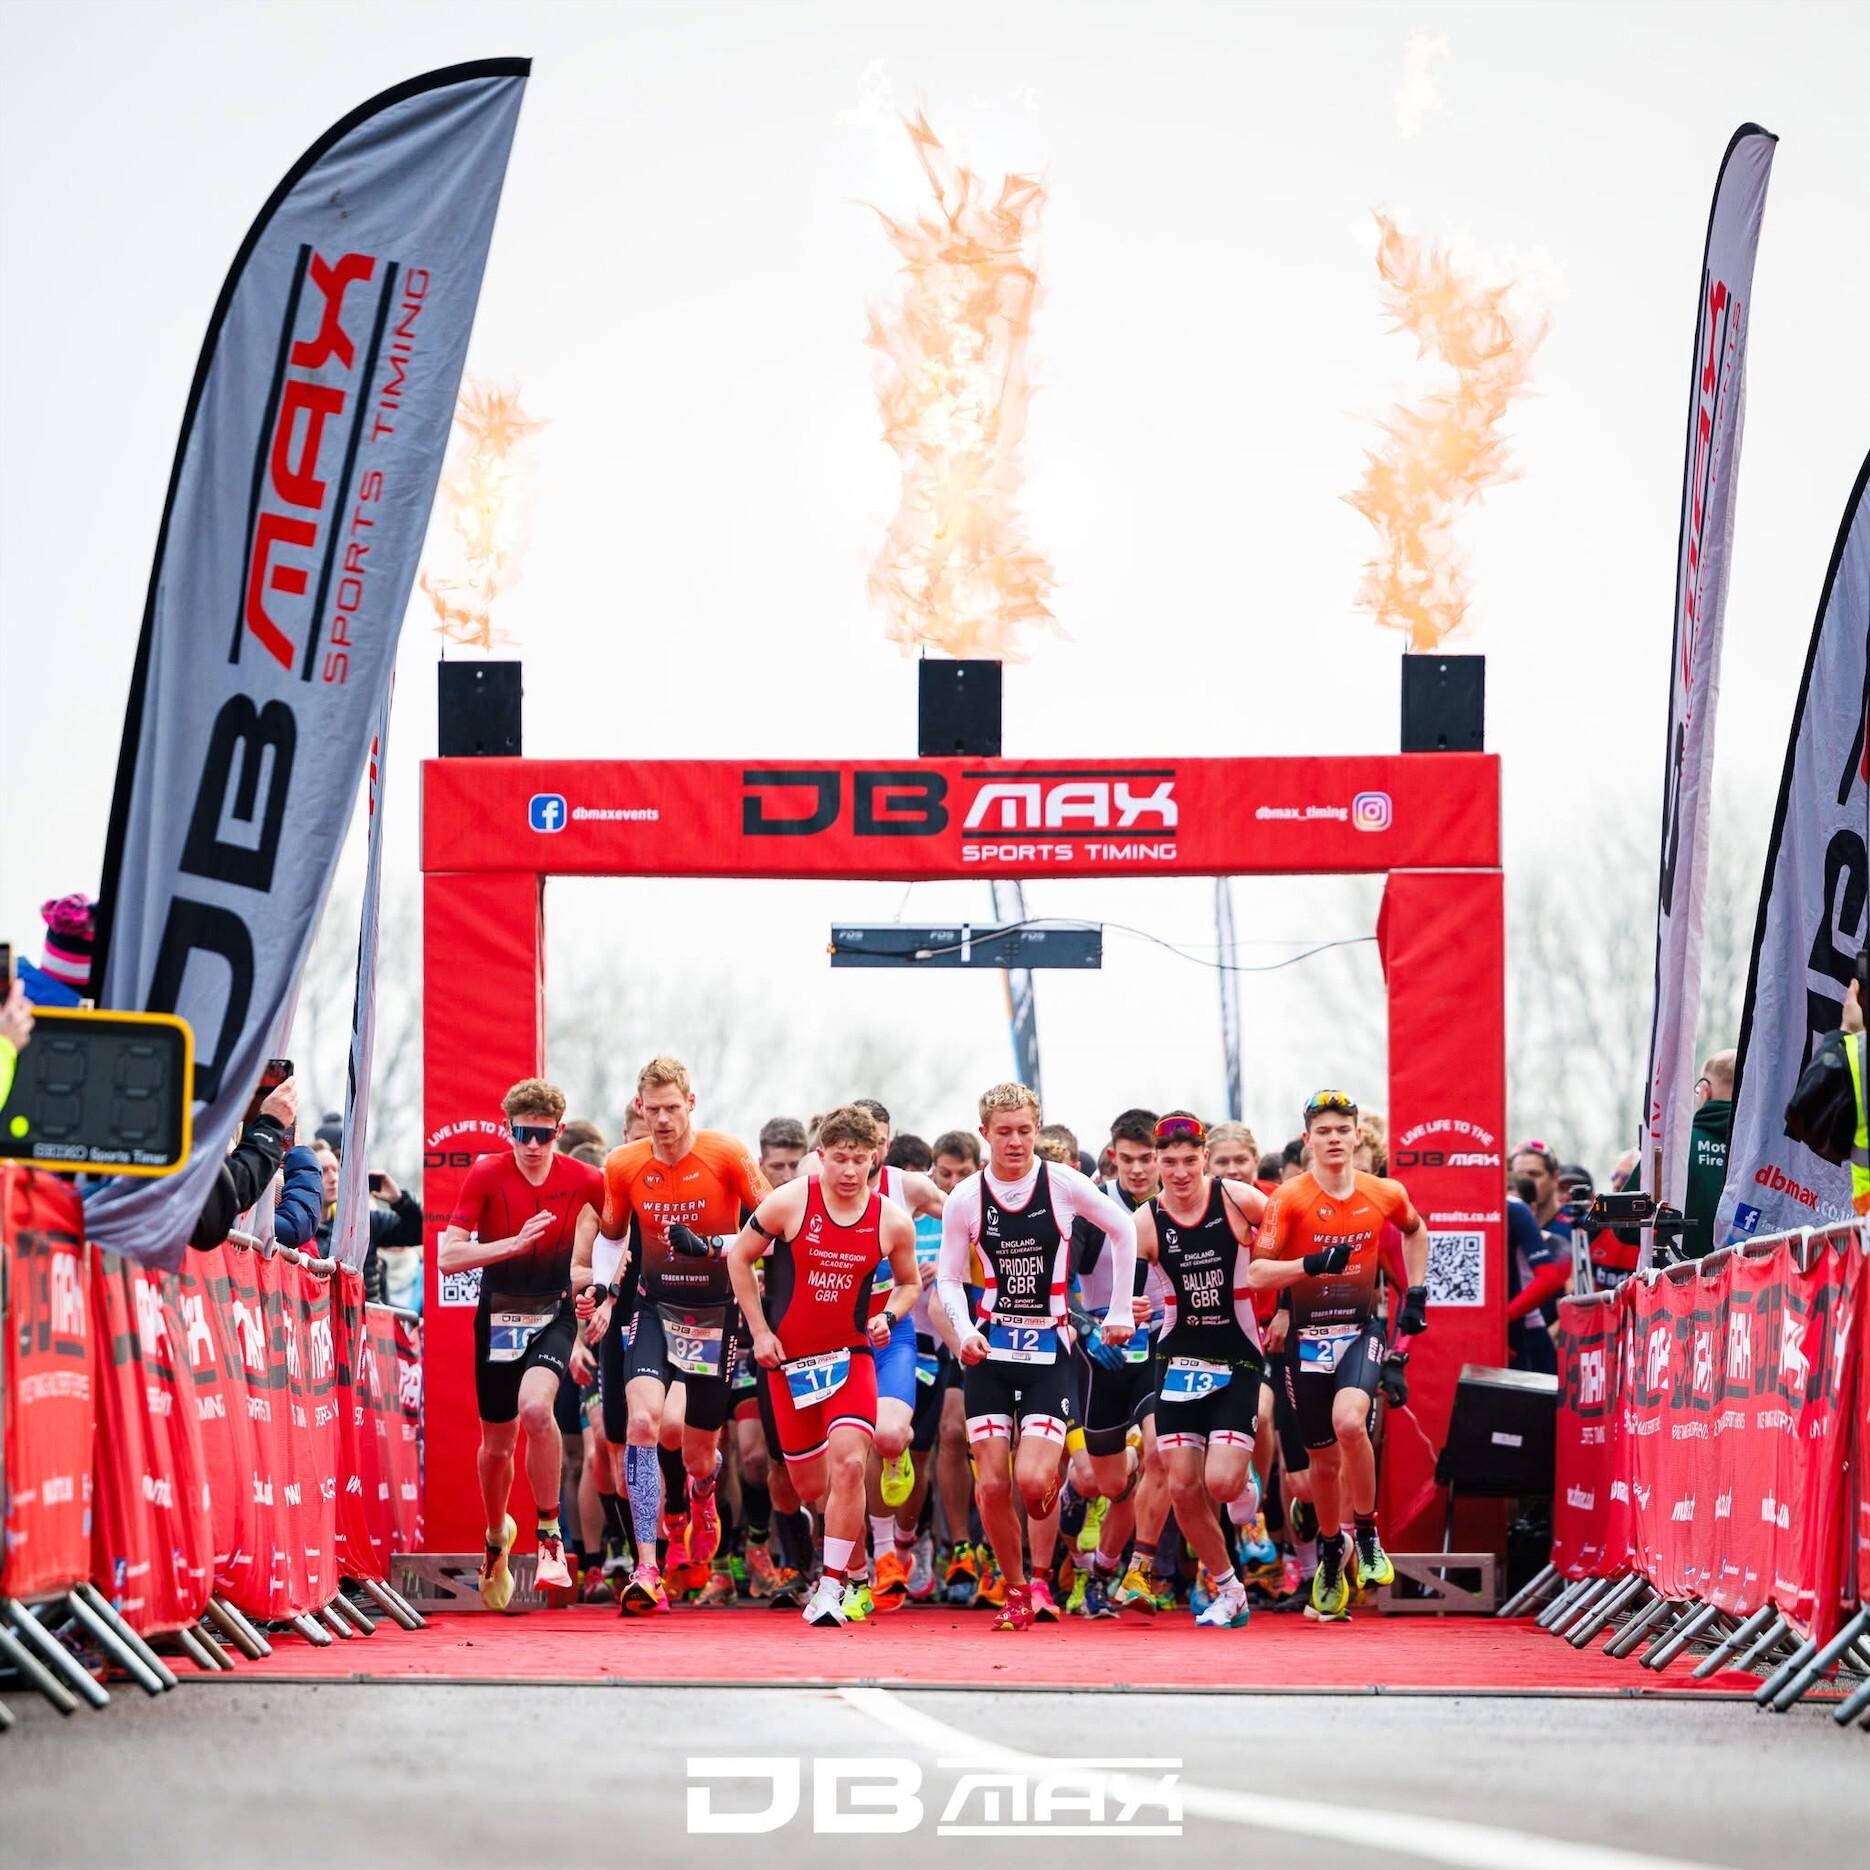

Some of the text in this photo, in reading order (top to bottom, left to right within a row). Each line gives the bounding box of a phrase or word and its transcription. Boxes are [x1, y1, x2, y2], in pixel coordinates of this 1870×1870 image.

[246, 250, 377, 670] MAX
[323, 268, 430, 685] SPORTS TIMING
[742, 770, 1178, 836] DB MAX
[572, 806, 659, 820] dbmaxevents
[1255, 805, 1348, 821] dbmax_timing
[962, 843, 1177, 861] SPORTS TIMING
[427, 1125, 453, 1147] LIVE
[452, 1120, 478, 1133] LIFE
[480, 1120, 496, 1134] TO
[1400, 1119, 1494, 1146] LIVE LIFE TO THE
[32, 1143, 88, 1160] SEIKO
[1396, 1152, 1500, 1167] DB MAX
[1698, 1154, 1724, 1166] Fire
[643, 1199, 706, 1212] WESTERN
[653, 1213, 699, 1222] TEMPO
[1001, 1238, 1036, 1249] ENGLAND
[1313, 1231, 1372, 1244] WESTERN
[809, 1248, 866, 1262] LONDON REGION
[1184, 1250, 1215, 1261] ENGLAND
[820, 1260, 854, 1269] ACADEMY
[999, 1256, 1044, 1276] PRIDDEN
[808, 1270, 853, 1290] MARKS
[1007, 1276, 1036, 1295] GBR
[1182, 1268, 1224, 1291] BALLARD
[815, 1289, 838, 1303] GBR
[1191, 1289, 1221, 1308] GBR
[1008, 1329, 1039, 1350] 12
[675, 1337, 704, 1361] 92
[805, 1365, 834, 1391] 17
[1184, 1372, 1213, 1392] 13
